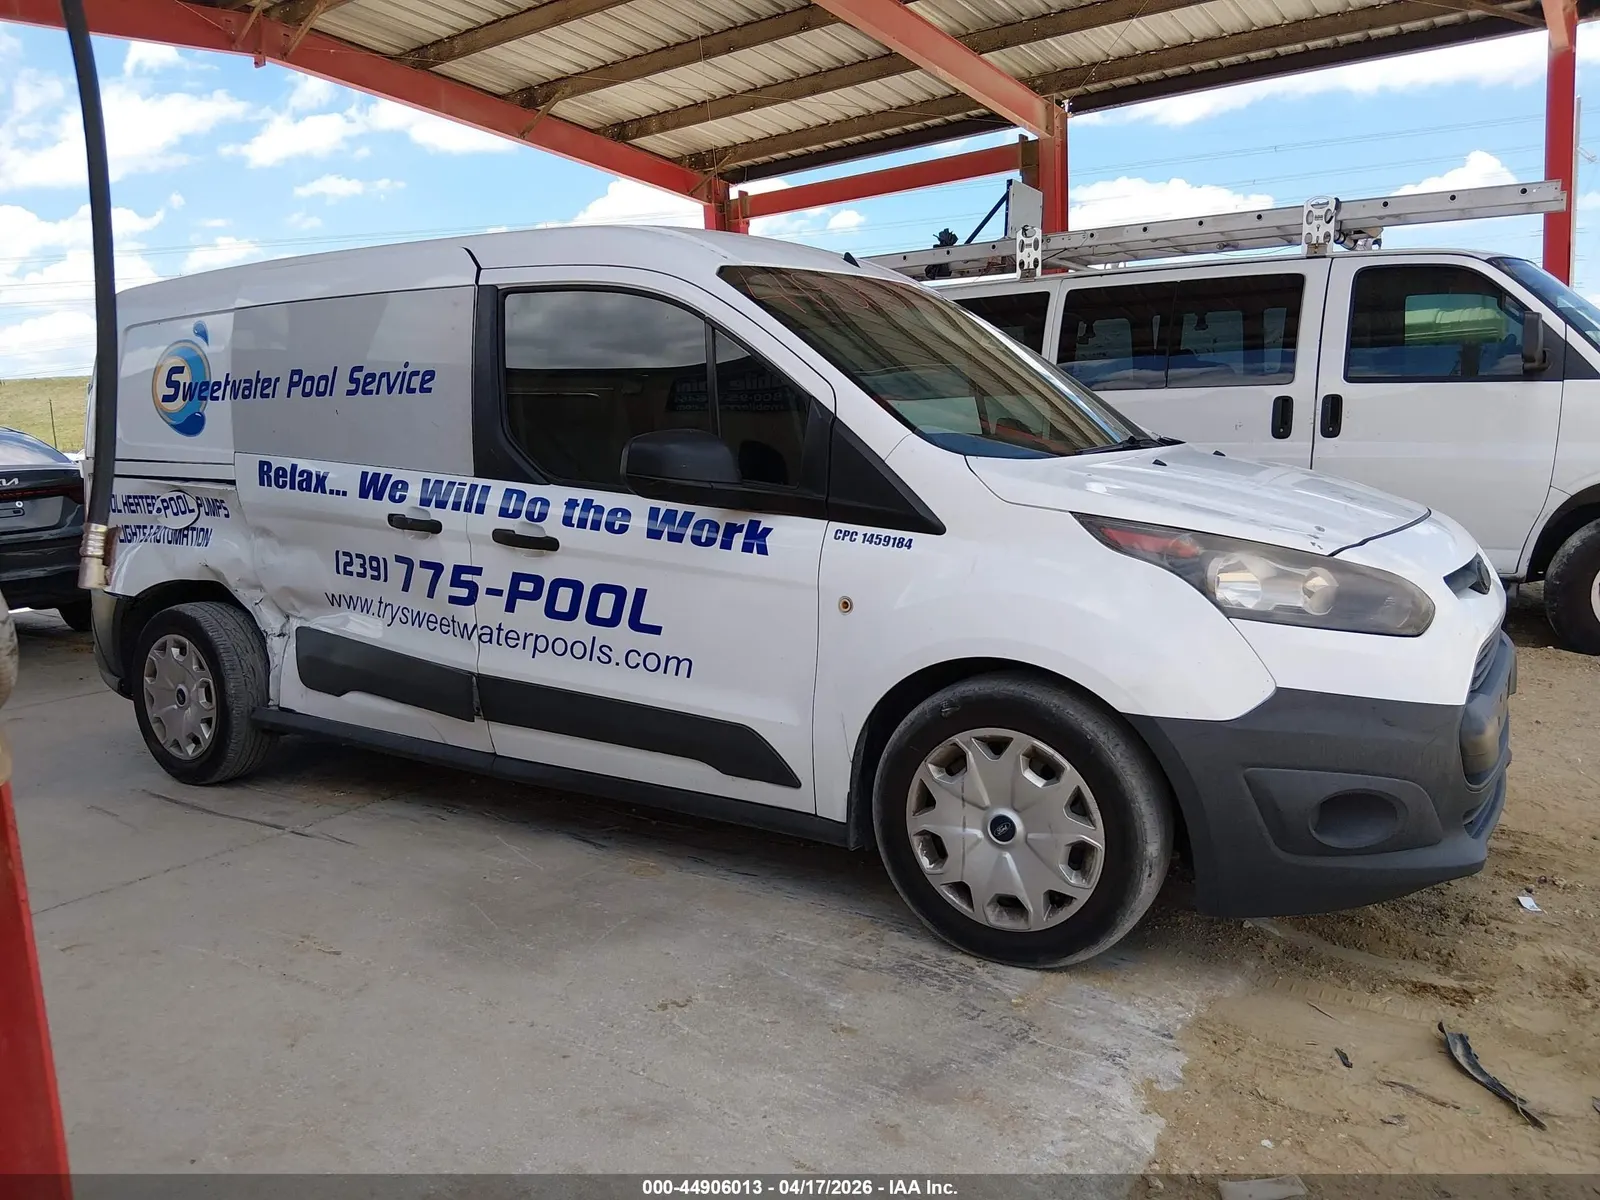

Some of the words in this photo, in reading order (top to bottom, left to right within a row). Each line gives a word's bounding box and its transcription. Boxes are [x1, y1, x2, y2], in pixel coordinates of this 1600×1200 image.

[161, 366, 281, 403] Sweetwater
[286, 366, 338, 398] Pool
[346, 361, 436, 397] Service
[195, 495, 230, 518] PUMPS
[258, 459, 348, 497] Relax...
[358, 471, 410, 503] We
[419, 478, 492, 515] Will
[497, 488, 551, 523] Do
[562, 497, 632, 535] the
[646, 506, 774, 556] Work
[834, 528, 859, 543] CPC
[861, 532, 914, 550] 1459184
[334, 550, 389, 583] (239)
[394, 554, 663, 636] 775-POOL
[324, 591, 693, 680] www.trysweetwaterpools.com
